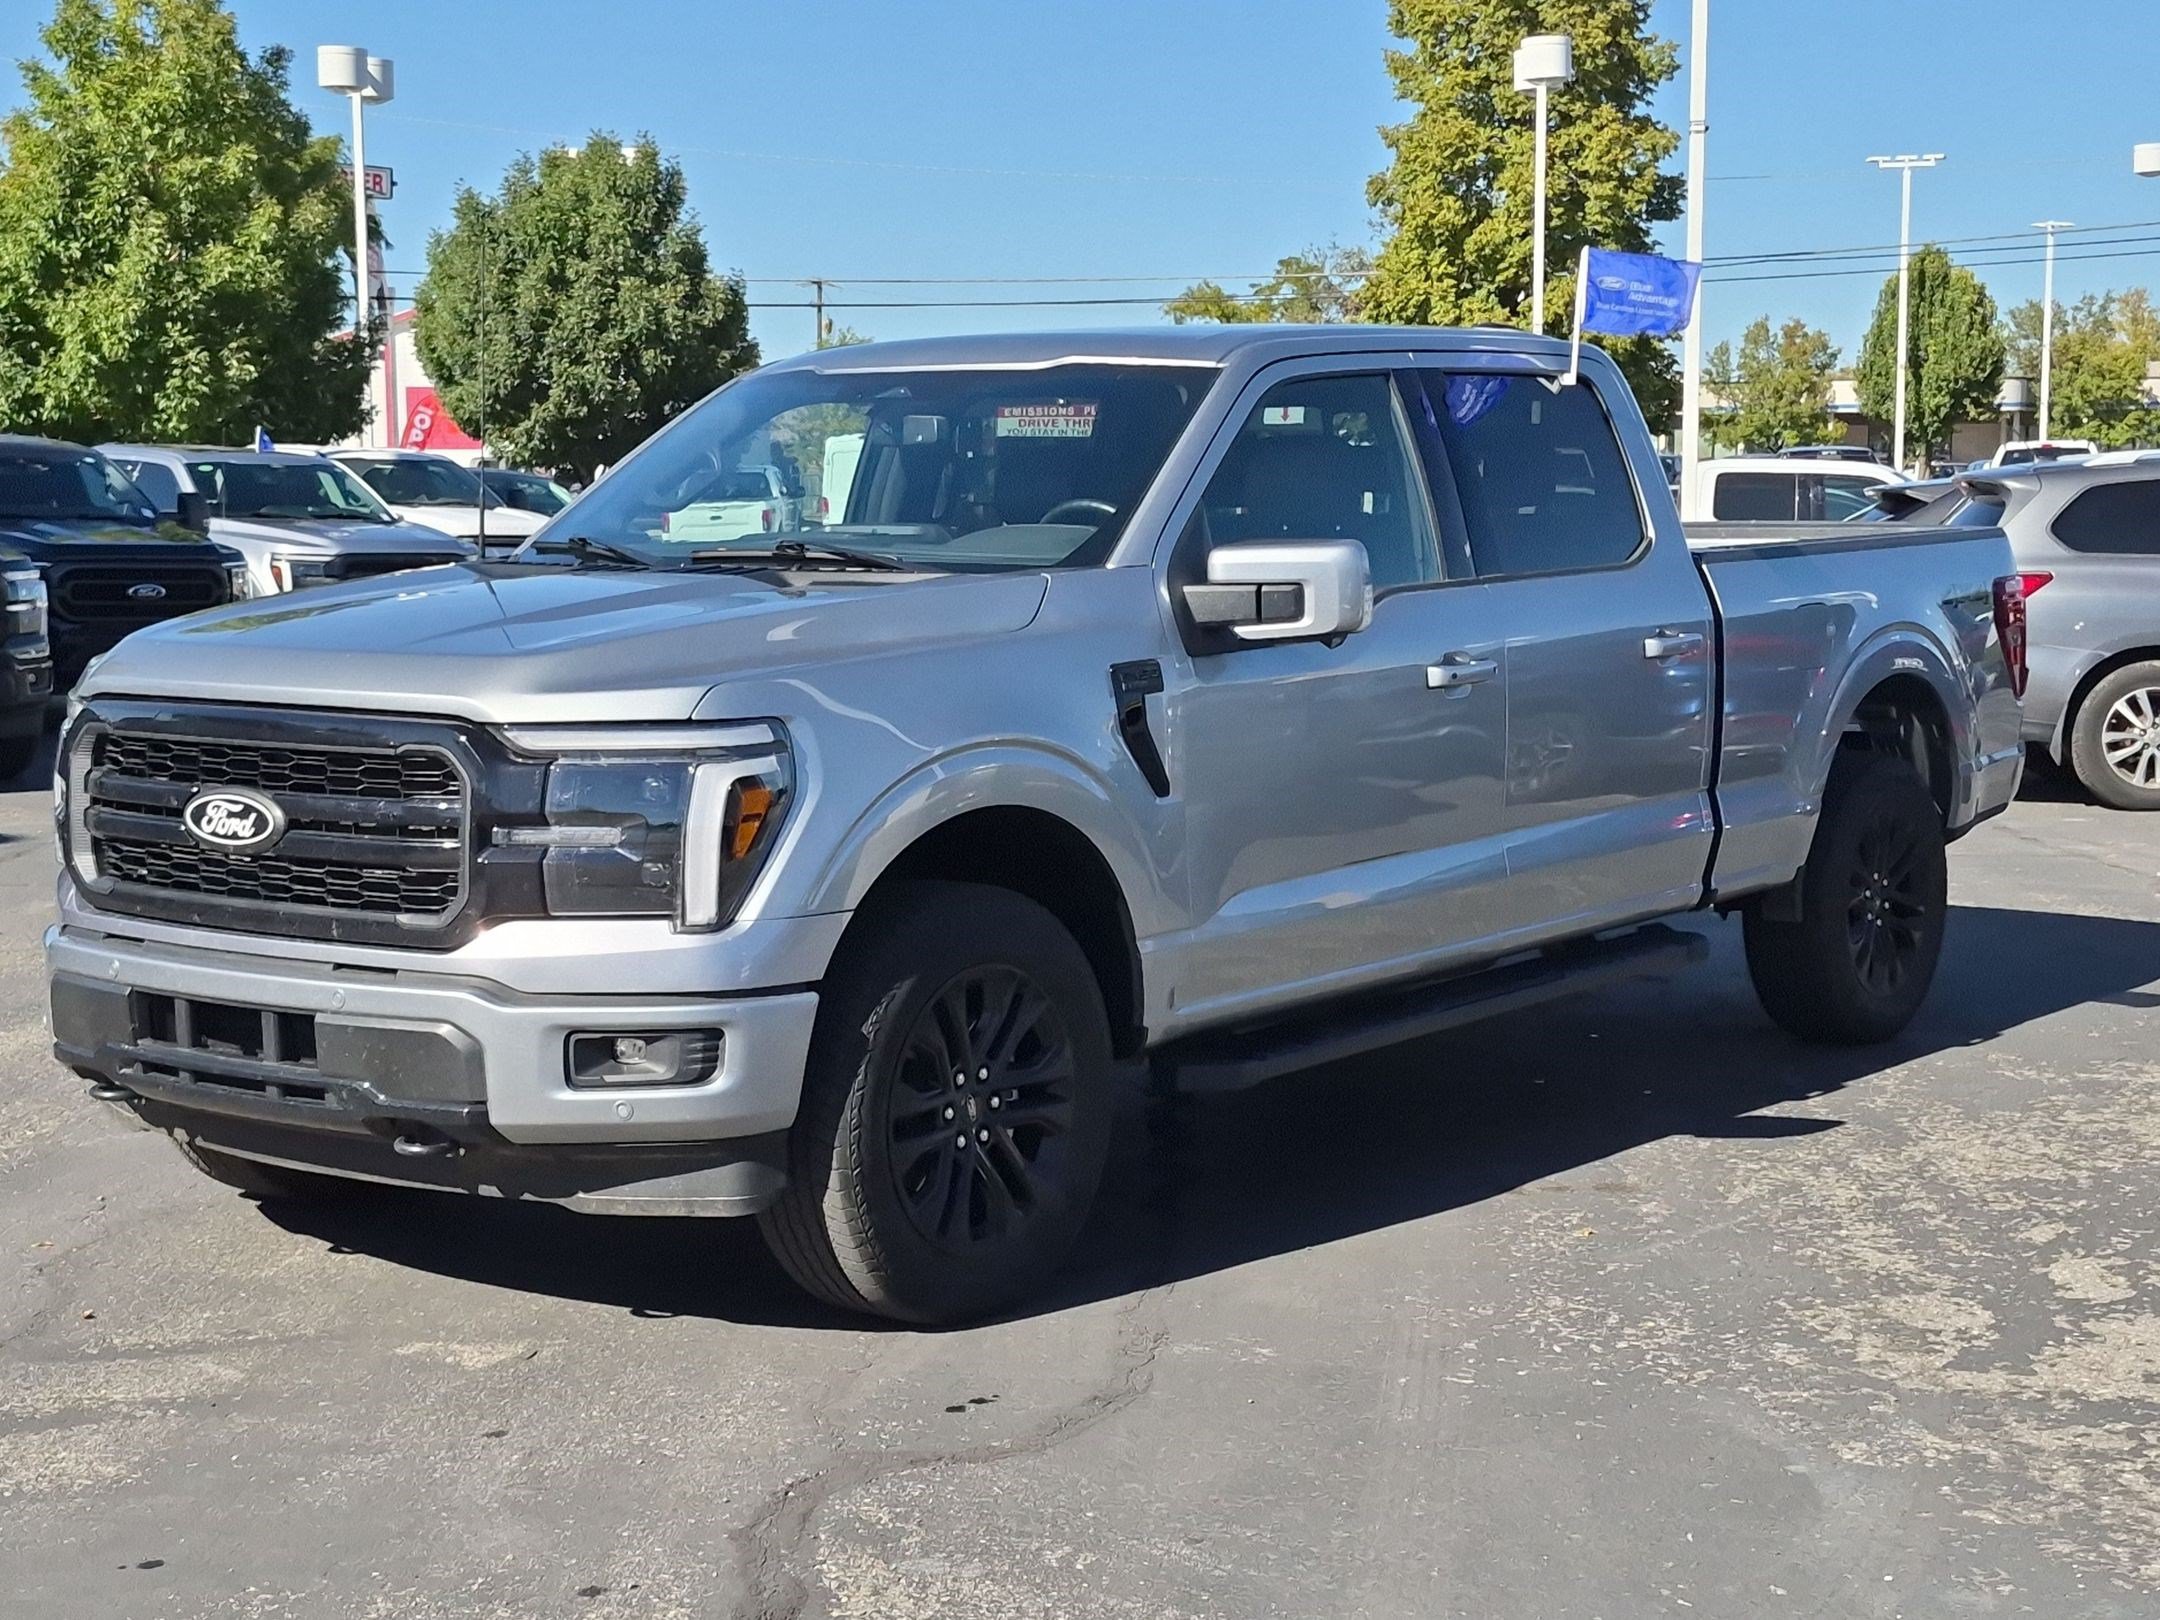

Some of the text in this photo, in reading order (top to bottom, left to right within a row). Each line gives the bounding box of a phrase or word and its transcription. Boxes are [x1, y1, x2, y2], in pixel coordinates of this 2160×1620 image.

[1004, 406, 1075, 417] EMISSIONS
[1018, 419, 1059, 428] DRIVE
[1007, 428, 1028, 436] YOU
[1030, 428, 1055, 436] STAY
[1058, 428, 1068, 436] IN
[201, 800, 257, 838] Ford
